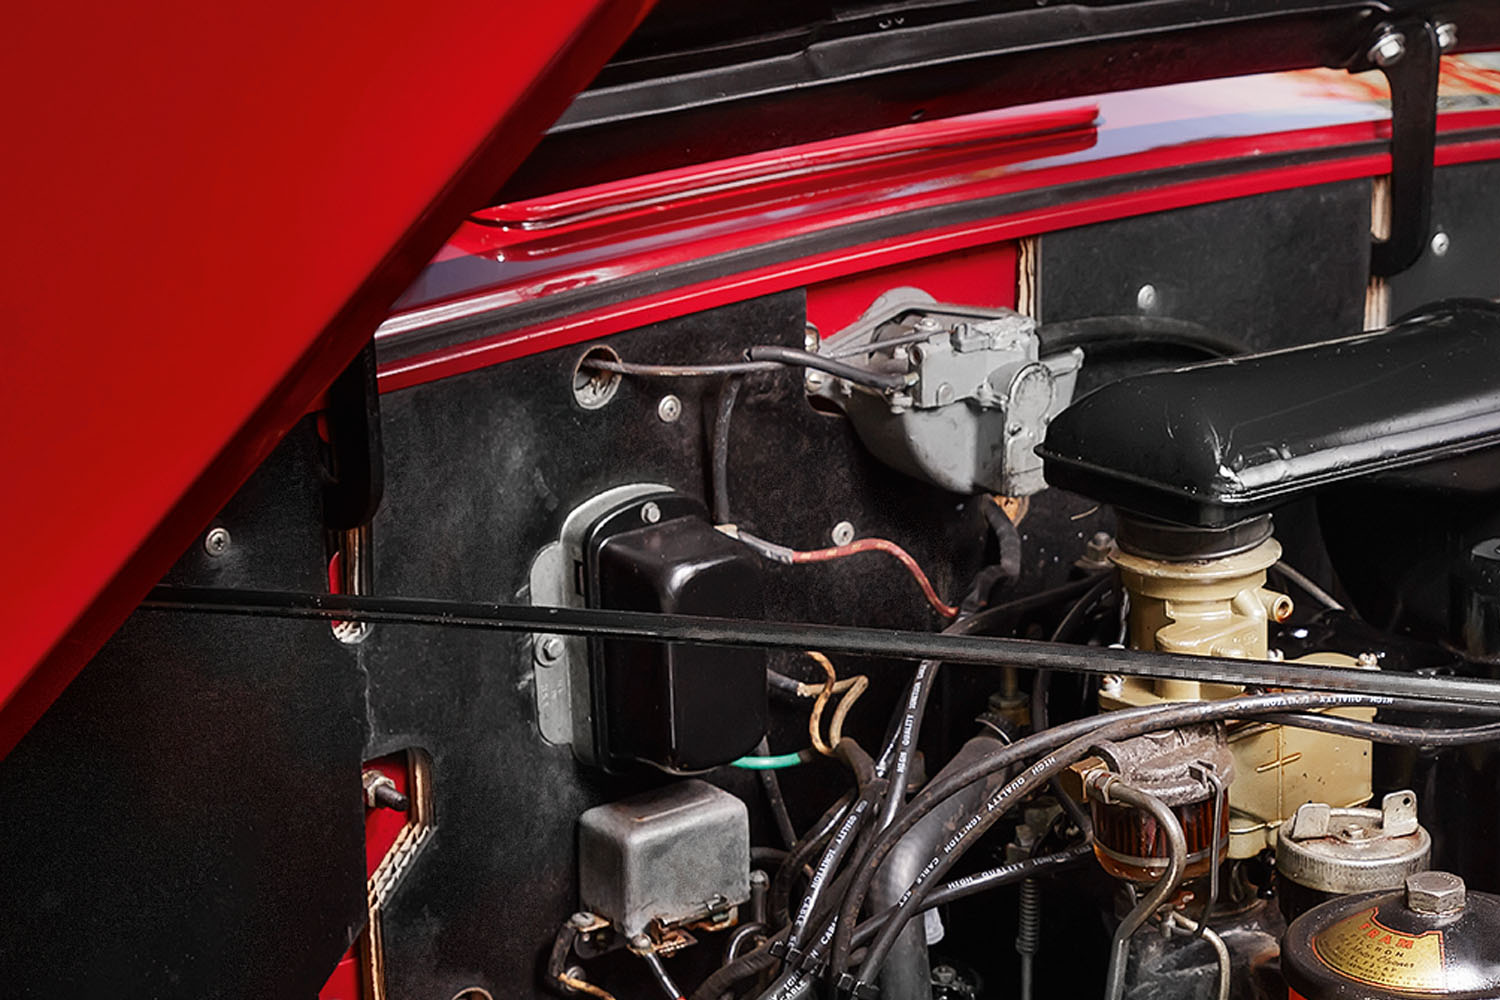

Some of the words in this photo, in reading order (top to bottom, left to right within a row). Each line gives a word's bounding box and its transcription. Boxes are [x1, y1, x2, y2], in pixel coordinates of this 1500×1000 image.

[1031, 756, 1056, 775] HIGH
[987, 776, 1025, 811] QUALITY
[835, 814, 856, 845] QUALITY
[942, 813, 982, 853] IGNITION
[811, 848, 835, 890] IGNITION
[947, 875, 973, 889] HIGH
[980, 861, 1024, 878] QUALITY
[795, 895, 813, 928] CABLE
[1358, 922, 1414, 949] FRAM
